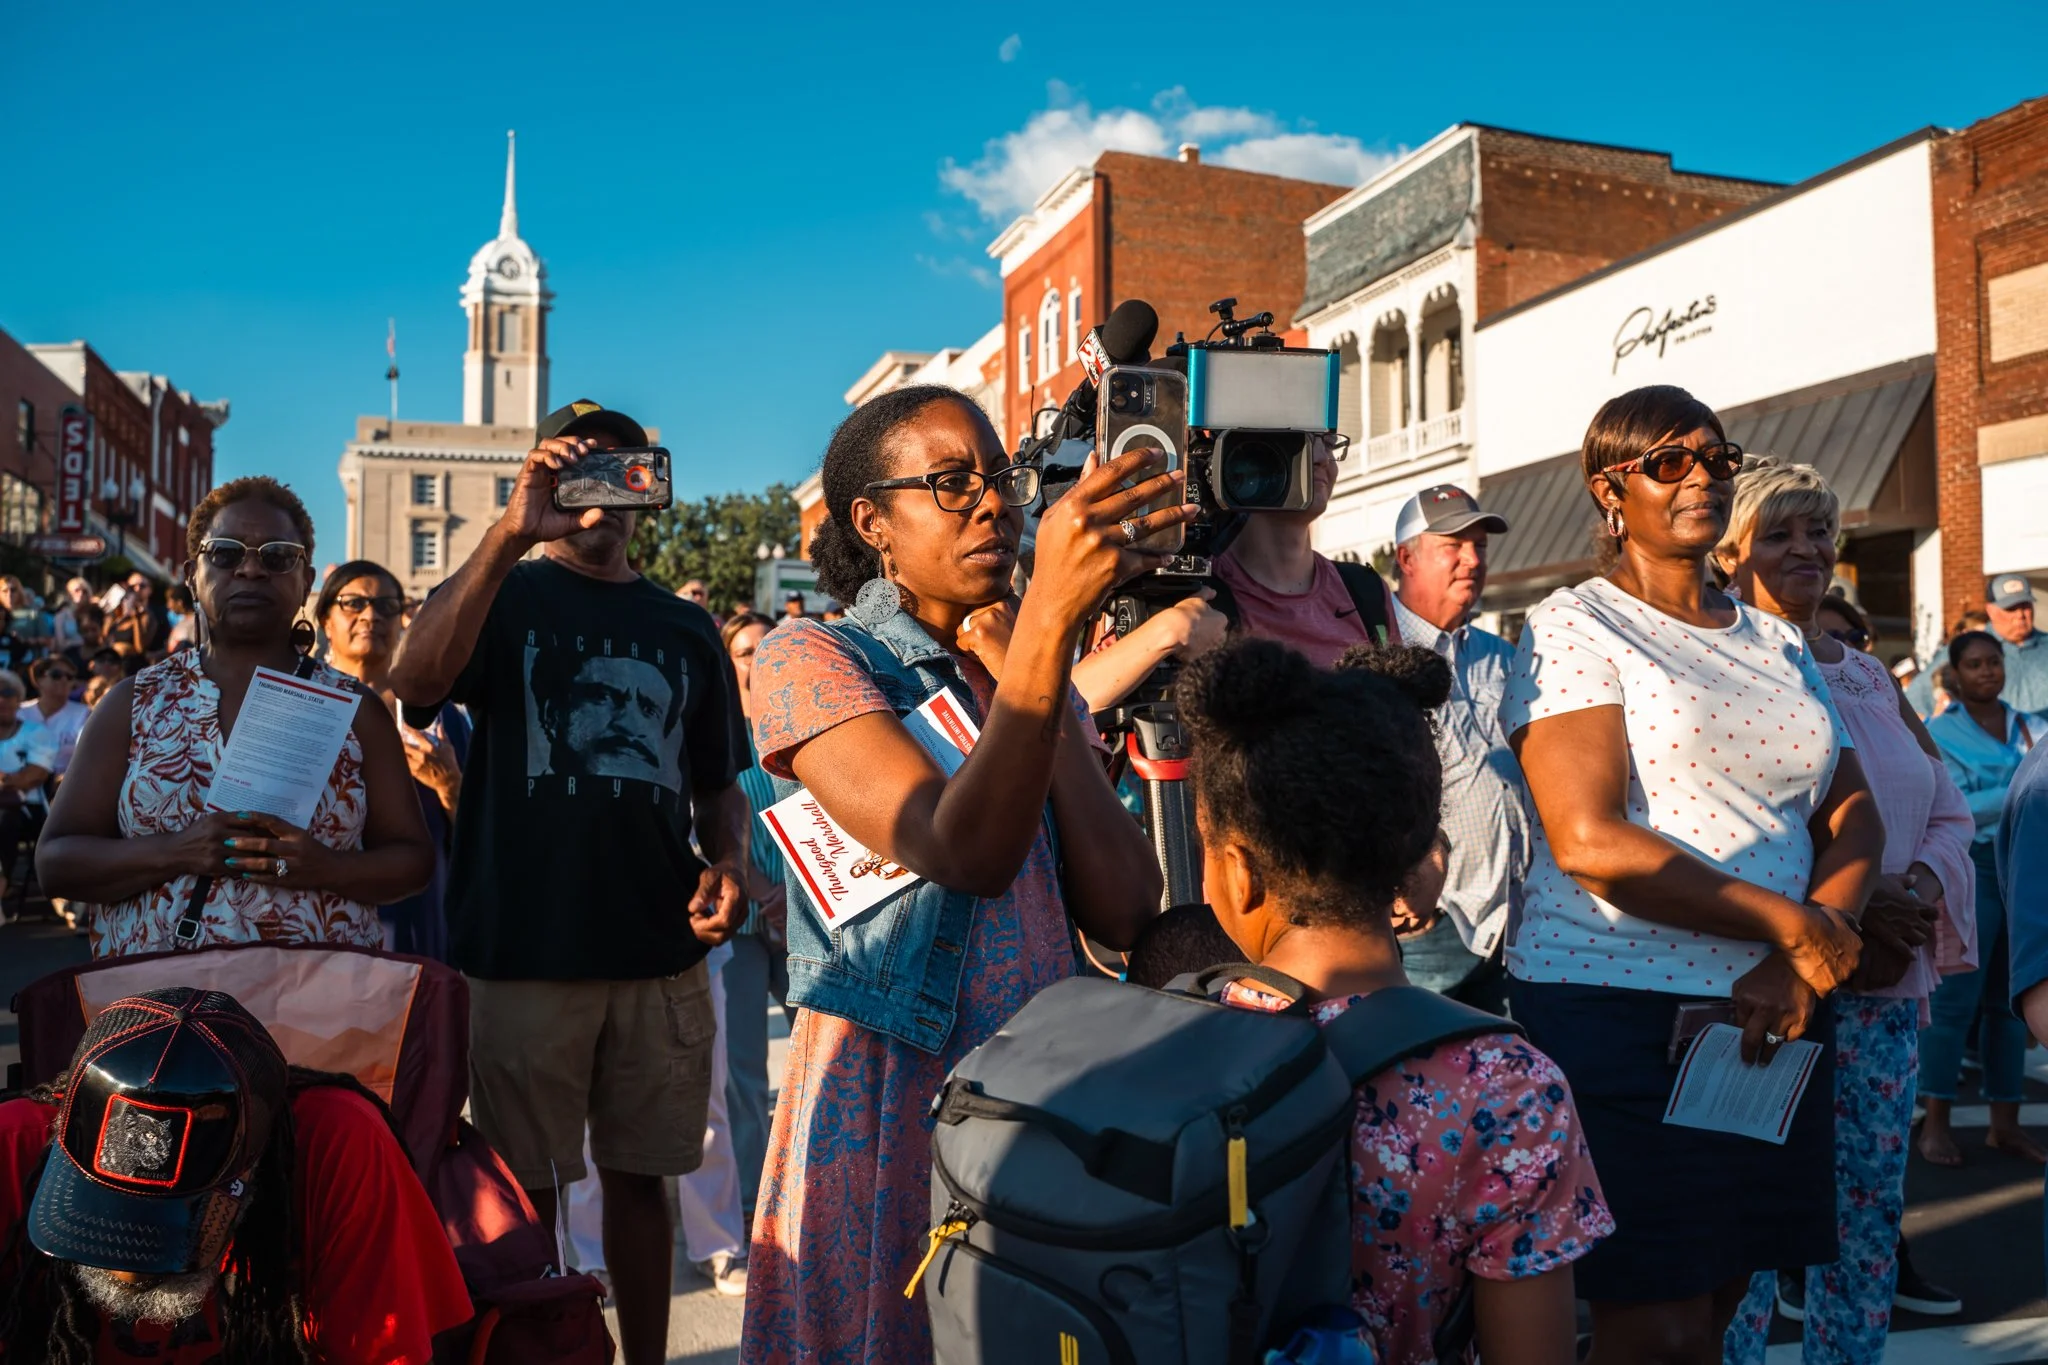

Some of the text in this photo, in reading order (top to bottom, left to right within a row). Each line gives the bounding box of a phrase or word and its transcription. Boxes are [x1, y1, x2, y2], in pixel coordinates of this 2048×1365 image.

[1079, 343, 1096, 373] 2
[527, 629, 688, 674] RICHARD
[258, 681, 325, 705] THURGOOD MARSHALL STATUE
[801, 799, 850, 860] Marshall
[800, 838, 849, 901] Thurgood
